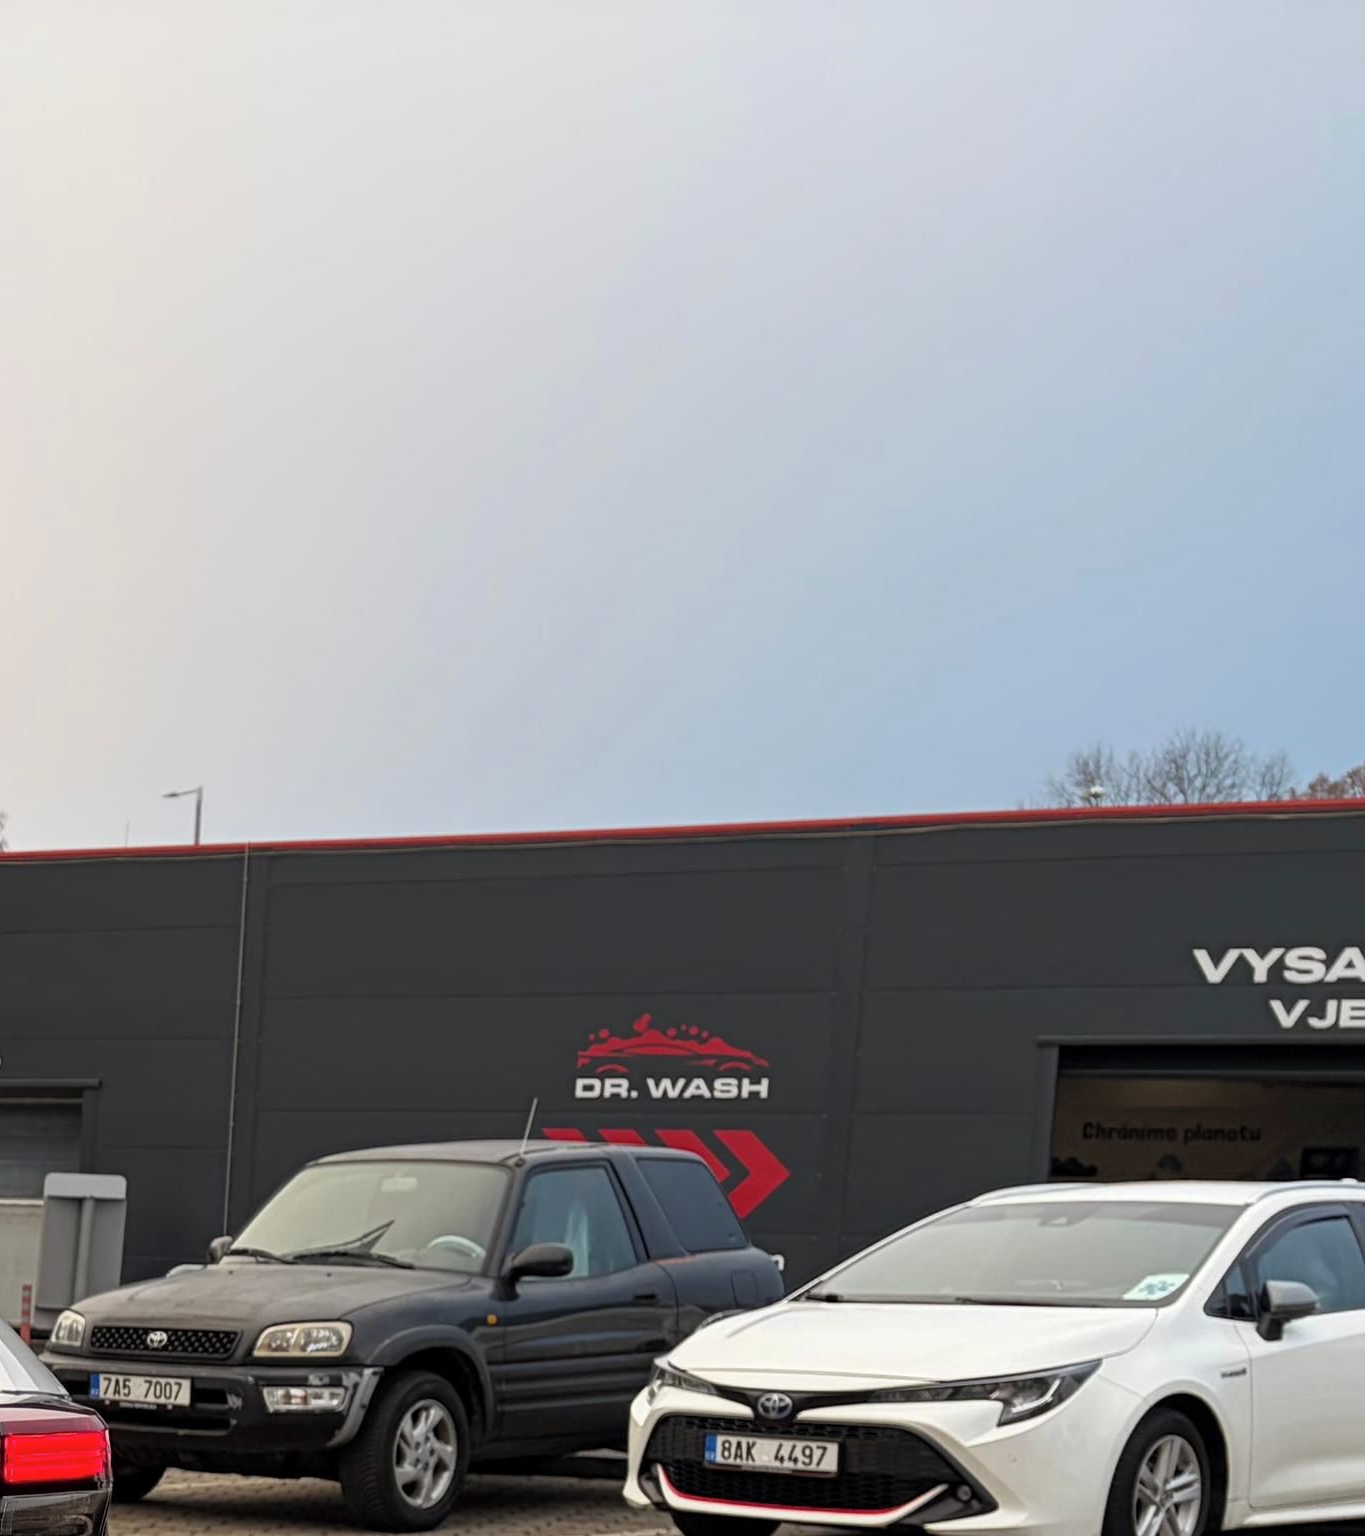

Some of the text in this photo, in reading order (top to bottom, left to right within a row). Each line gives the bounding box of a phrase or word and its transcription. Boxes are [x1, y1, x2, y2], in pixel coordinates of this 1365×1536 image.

[1192, 946, 1365, 984] VYSA
[1269, 999, 1365, 1029] VJE
[575, 1077, 769, 1099] DR. WASH
[103, 1377, 183, 1401] 7A5 7007
[721, 1439, 828, 1467] 8AK 4497
